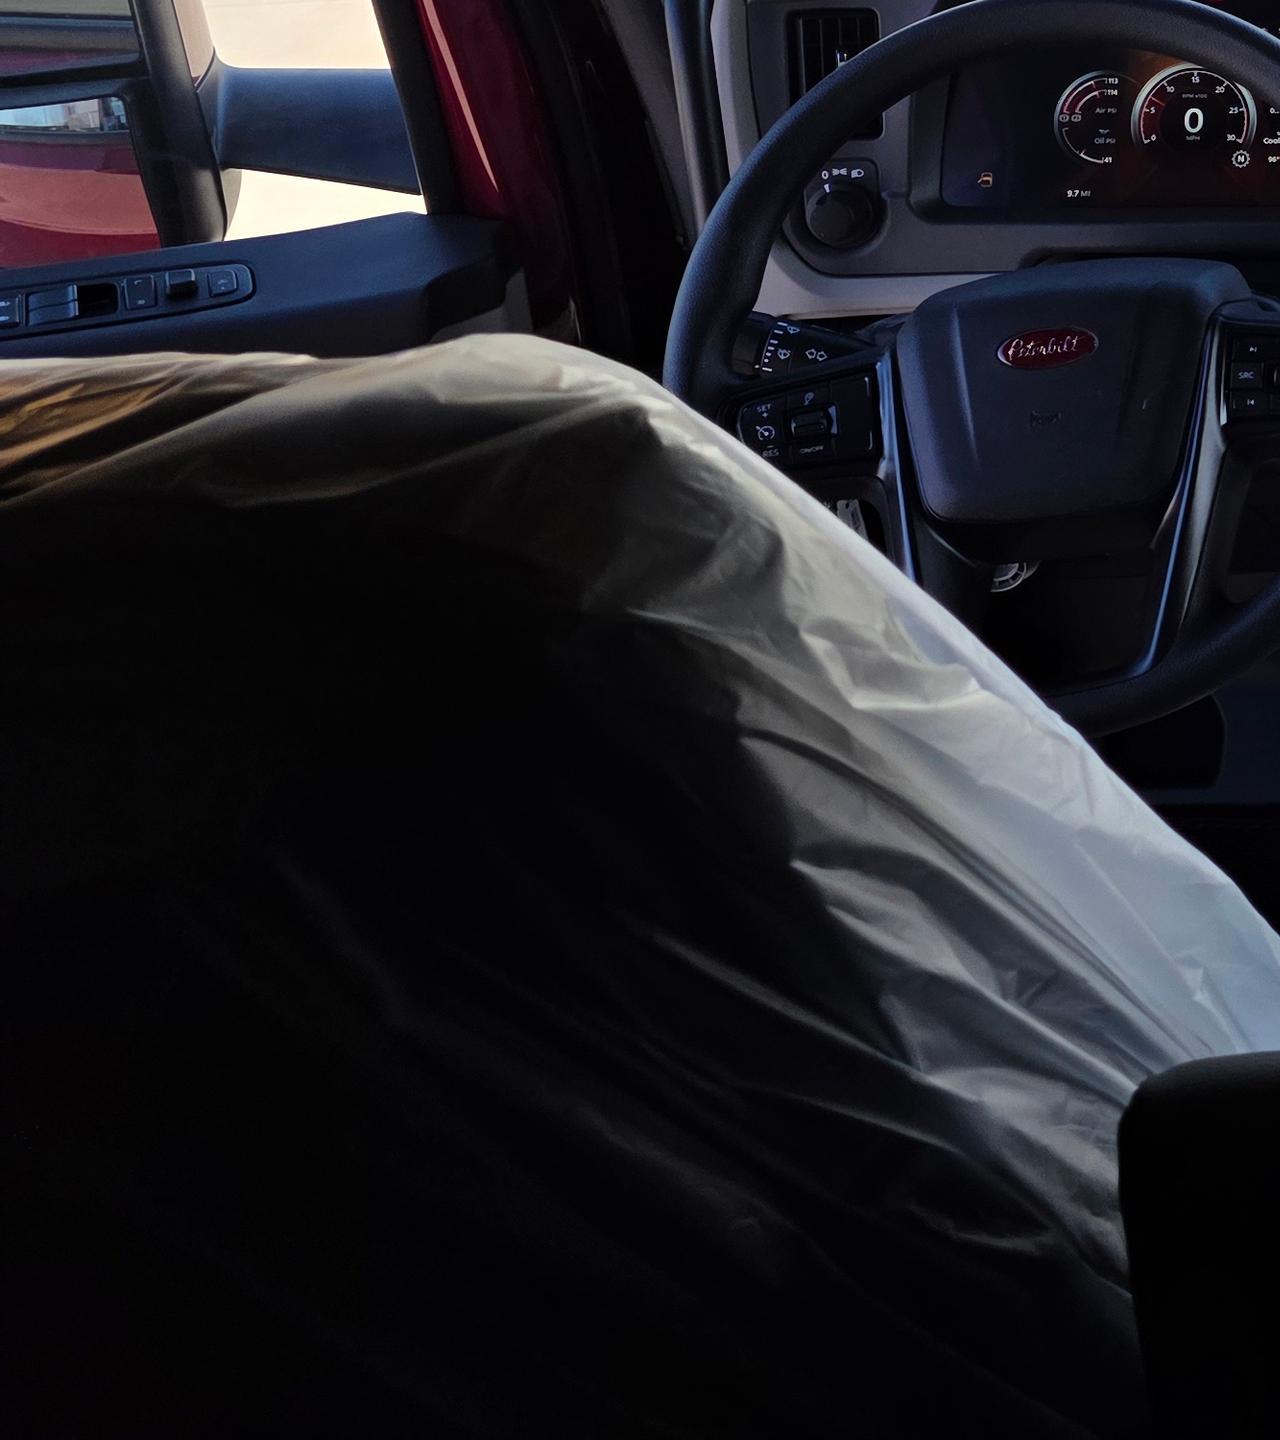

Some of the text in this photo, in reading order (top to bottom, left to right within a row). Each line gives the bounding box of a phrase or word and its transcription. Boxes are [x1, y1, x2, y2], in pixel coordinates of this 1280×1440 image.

[1191, 76, 1200, 84] 15
[1184, 108, 1204, 134] 0
[1094, 137, 1105, 145] Oil
[1150, 134, 1157, 142] 0
[1227, 134, 1236, 142] 30
[1067, 190, 1080, 198] 9.7
[1007, 335, 1087, 361] Peterbilt
[1238, 371, 1255, 379] SRC
[762, 448, 780, 458] RES
